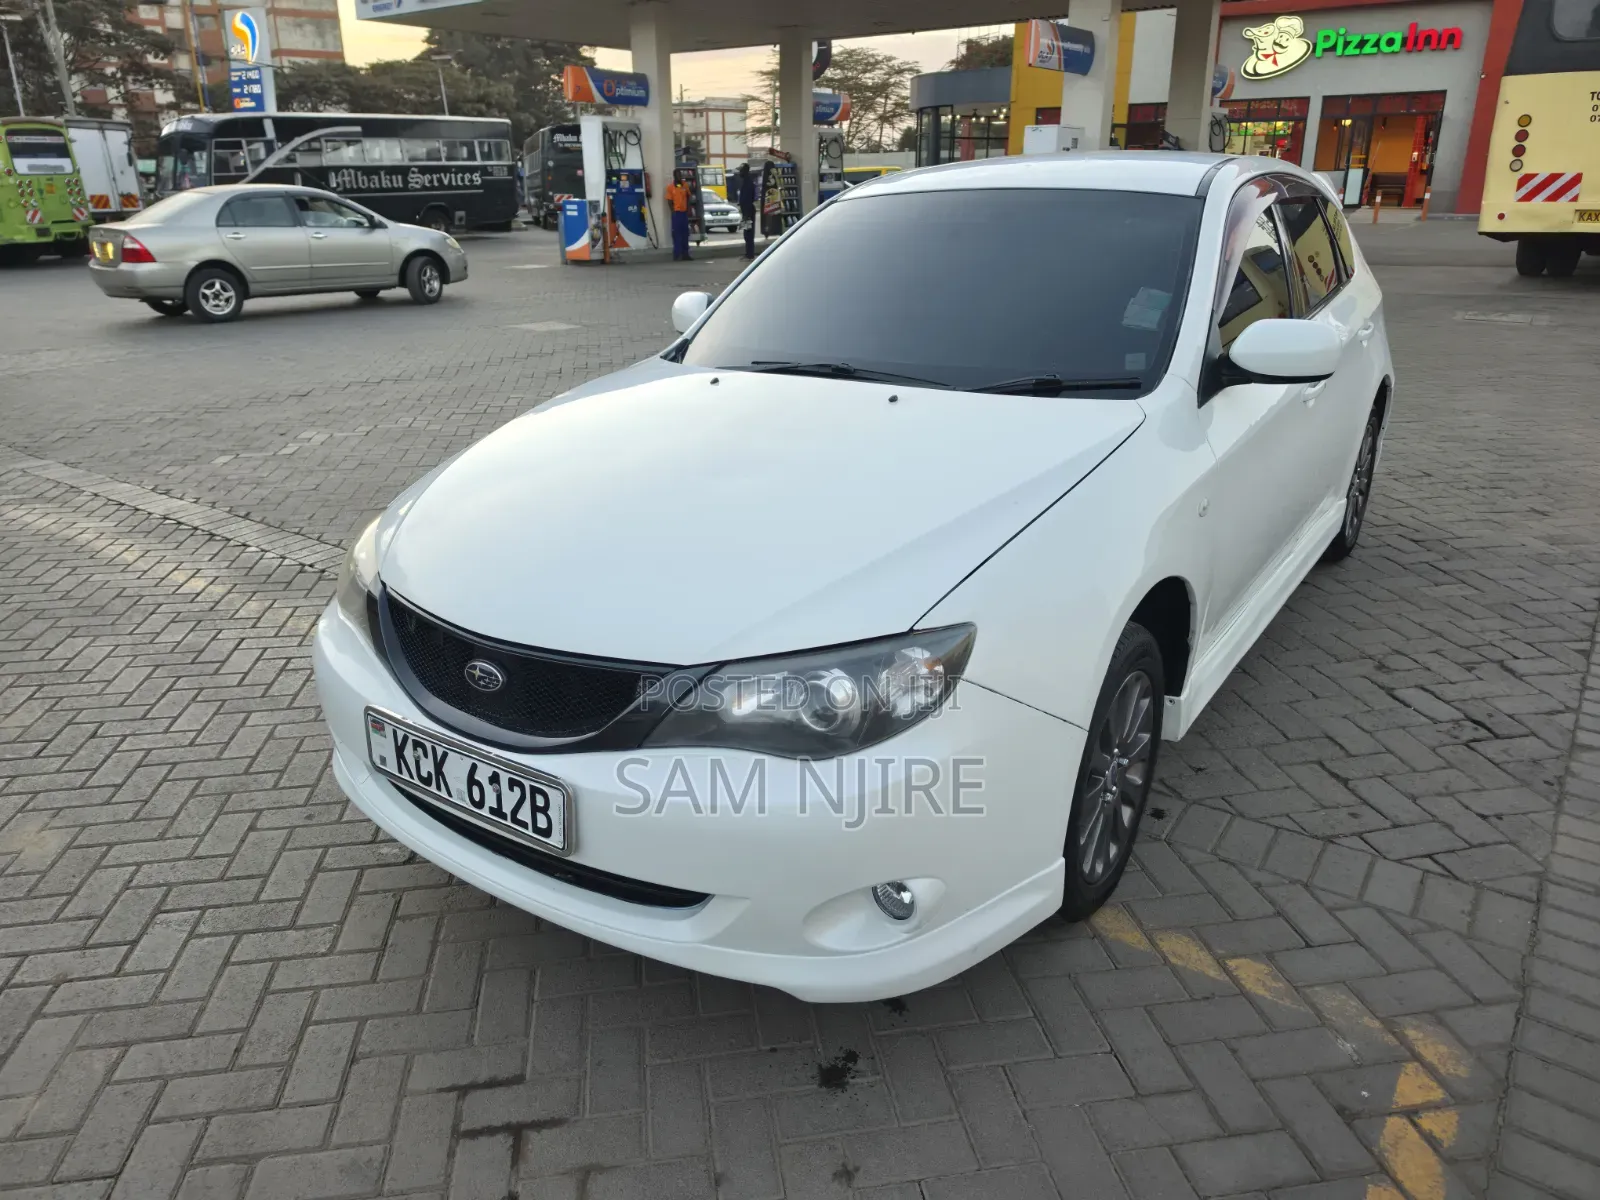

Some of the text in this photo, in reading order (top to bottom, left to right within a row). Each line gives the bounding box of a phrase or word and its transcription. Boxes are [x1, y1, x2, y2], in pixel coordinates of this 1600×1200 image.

[1315, 23, 1463, 58] Pizza Inn
[334, 168, 403, 189] Mbaku
[407, 167, 482, 189] Services
[392, 728, 453, 798] KCK
[466, 762, 553, 839] 612B
